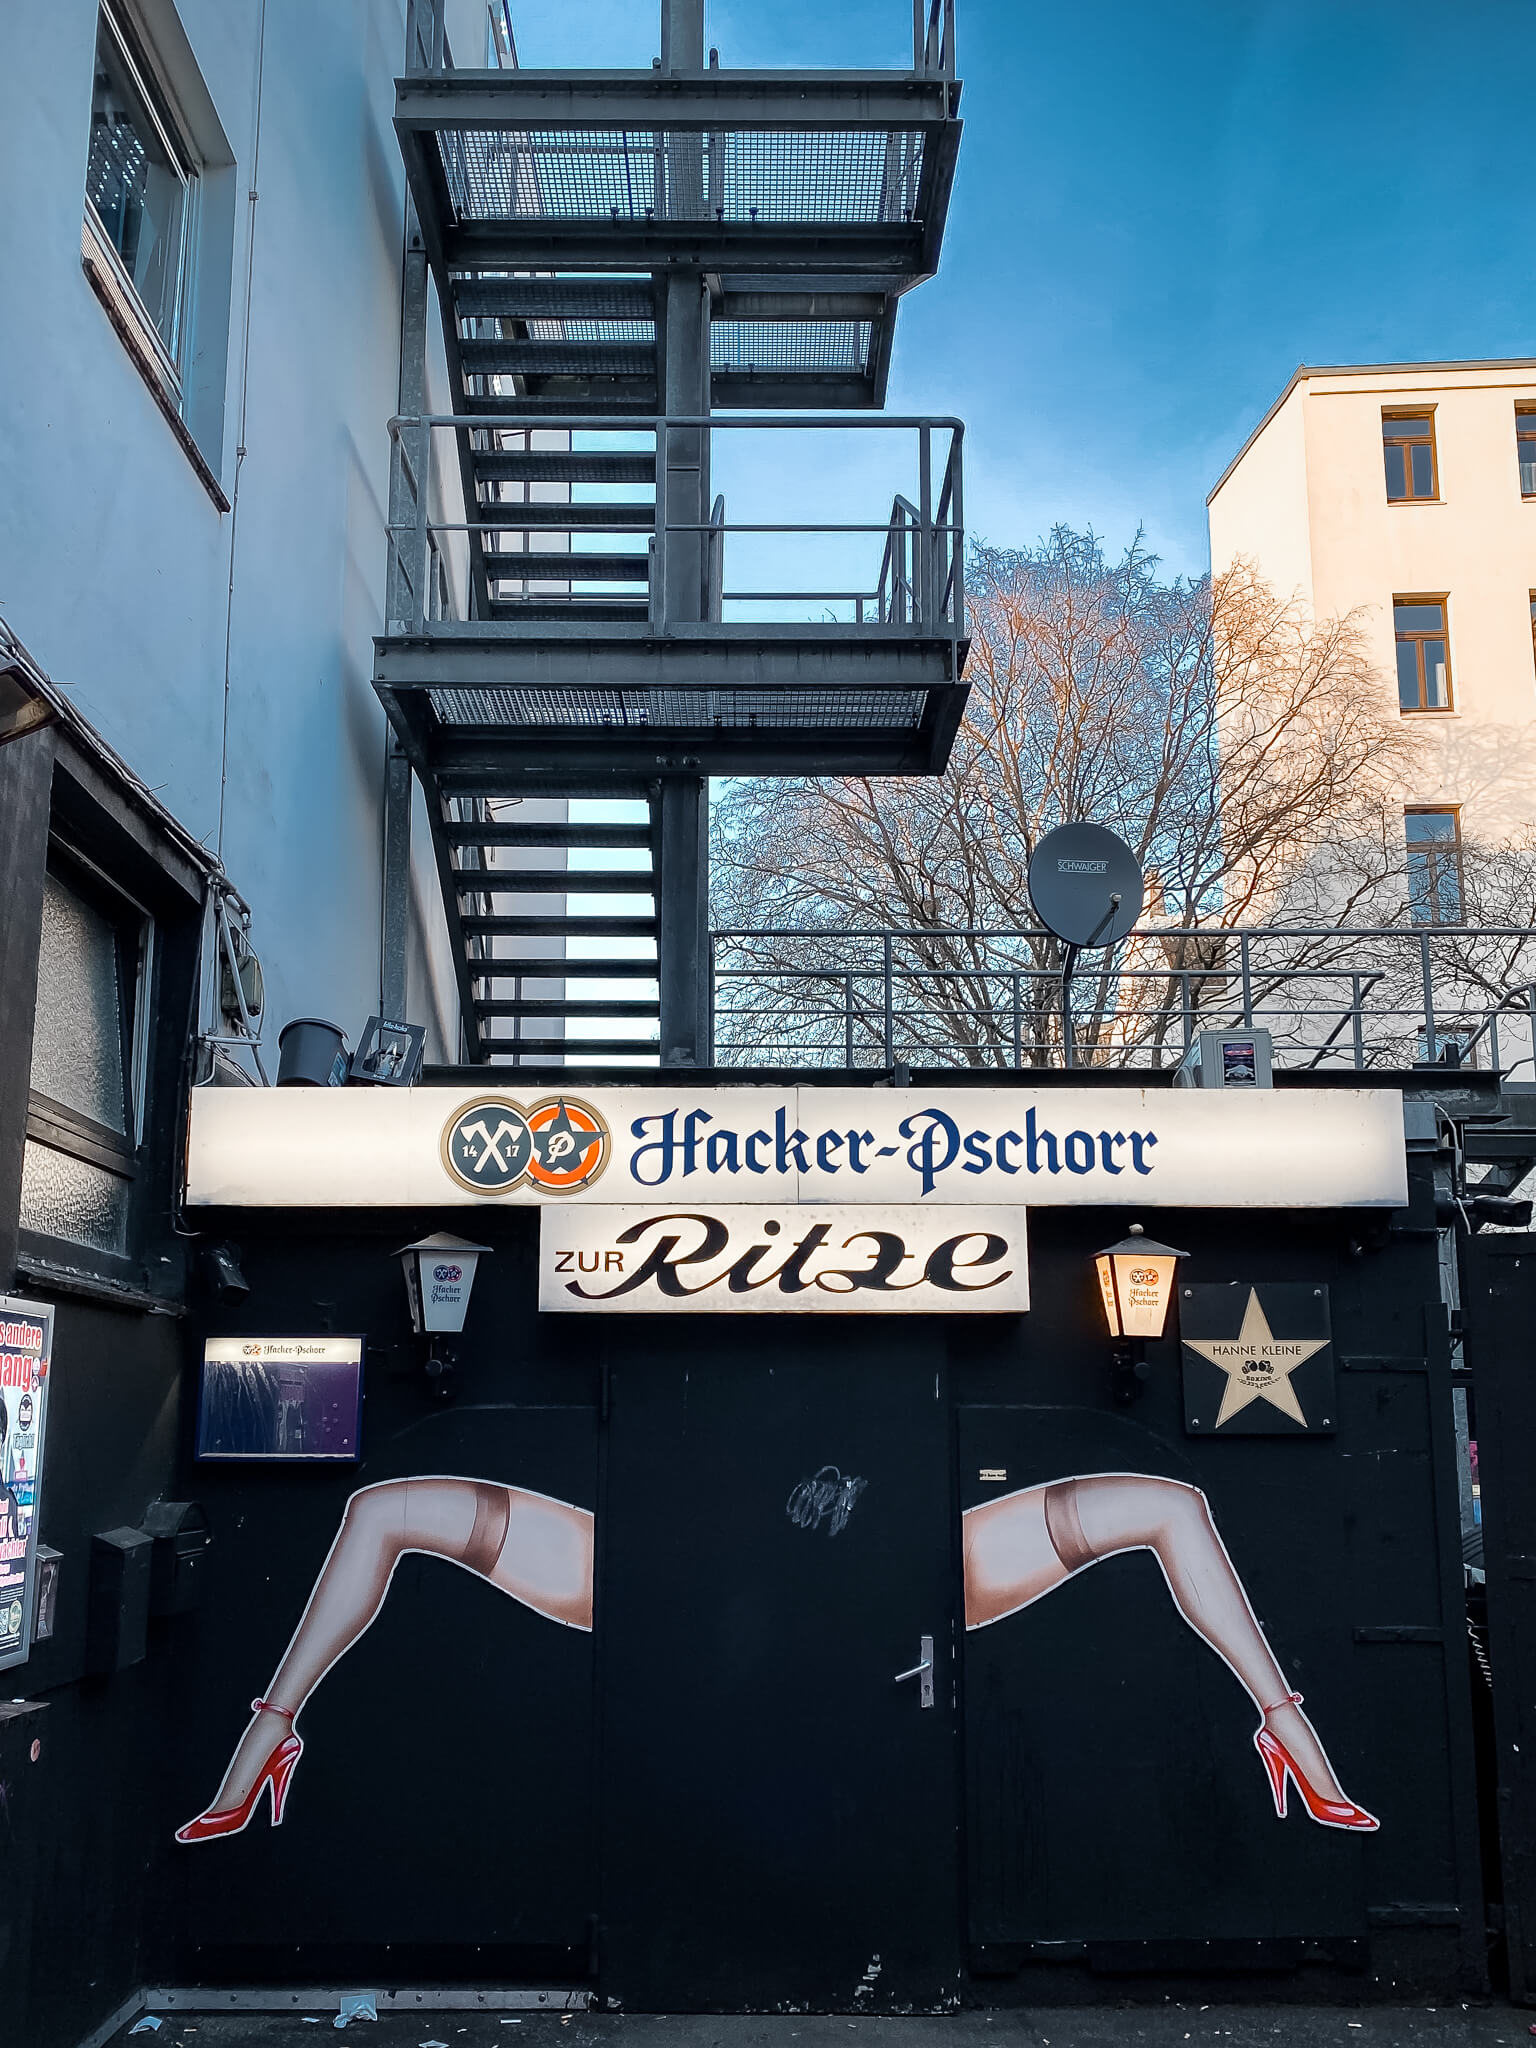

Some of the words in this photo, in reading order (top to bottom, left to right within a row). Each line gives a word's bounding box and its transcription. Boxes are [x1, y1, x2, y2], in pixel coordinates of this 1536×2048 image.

[1057, 861, 1107, 871] SCHWAIGER
[462, 1145, 478, 1158] 14
[505, 1145, 520, 1158] 17
[629, 1106, 1158, 1197] Hacker-Pschorr
[554, 1251, 625, 1273] ZUR
[565, 1213, 1013, 1300] Ritze
[6, 1322, 42, 1349] andere
[1212, 1345, 1257, 1356] HANNE
[1261, 1345, 1302, 1356] KLEINE
